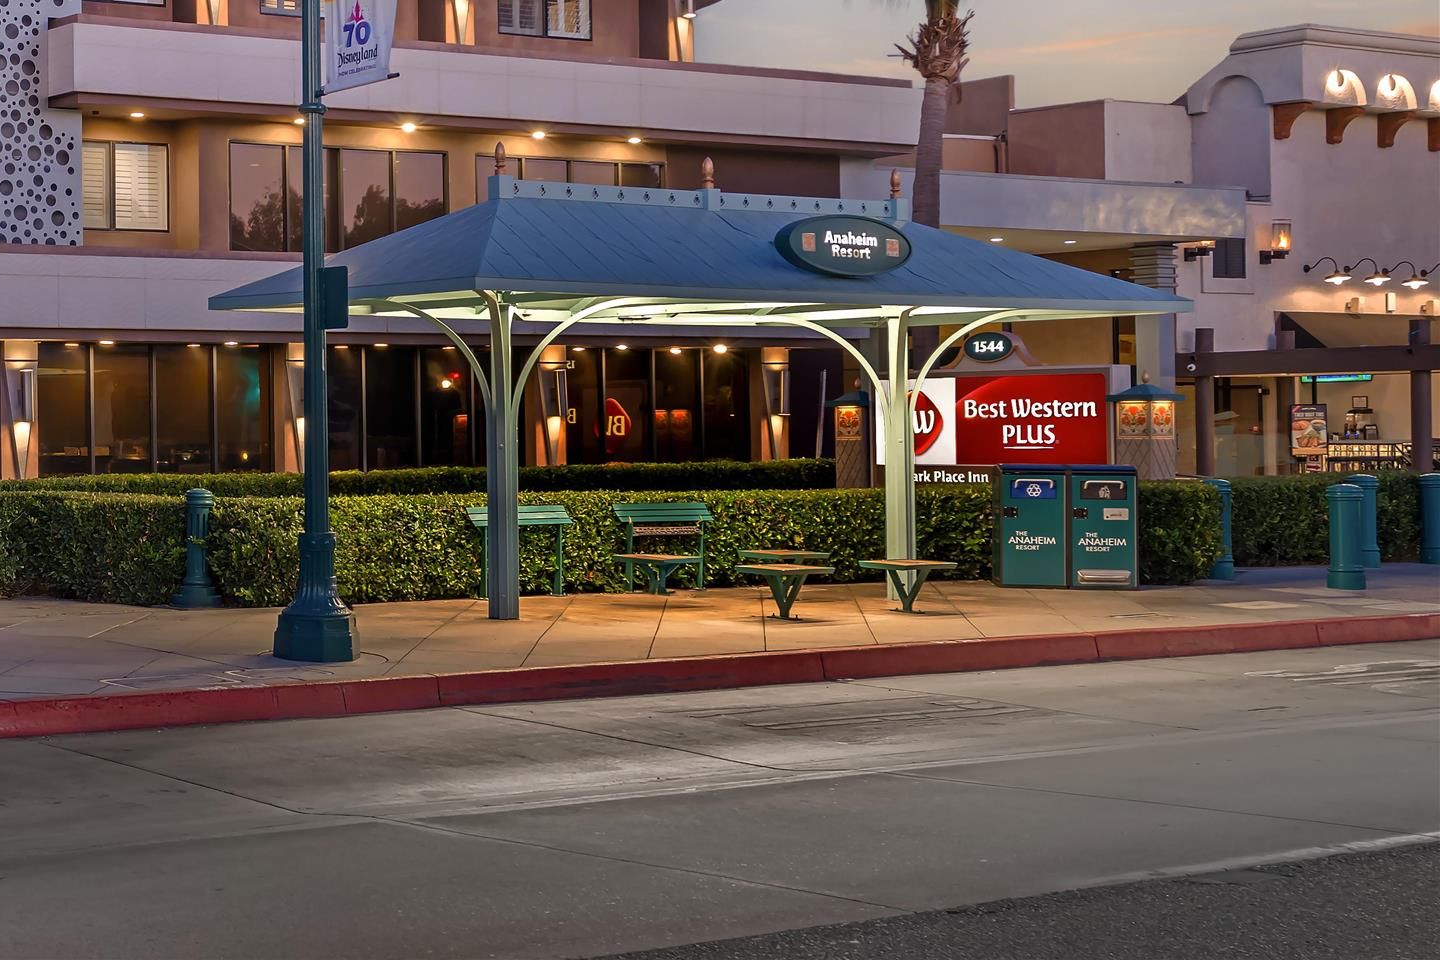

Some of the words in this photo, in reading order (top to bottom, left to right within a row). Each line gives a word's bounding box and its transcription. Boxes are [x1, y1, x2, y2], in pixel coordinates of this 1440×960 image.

[343, 21, 371, 48] 70
[337, 43, 378, 68] Disneyland
[824, 230, 878, 247] Anaheim
[831, 244, 871, 259] Resort
[973, 341, 1005, 353] 1544
[964, 400, 1008, 419] Best
[1010, 398, 1097, 418] Western
[913, 410, 935, 434] W
[1002, 424, 1056, 445] PLUS
[913, 470, 931, 483] ark
[934, 470, 966, 483] Place
[968, 471, 989, 483] Inn
[1008, 536, 1057, 545] ANAHEIM
[1078, 538, 1127, 546] ANAHEIM
